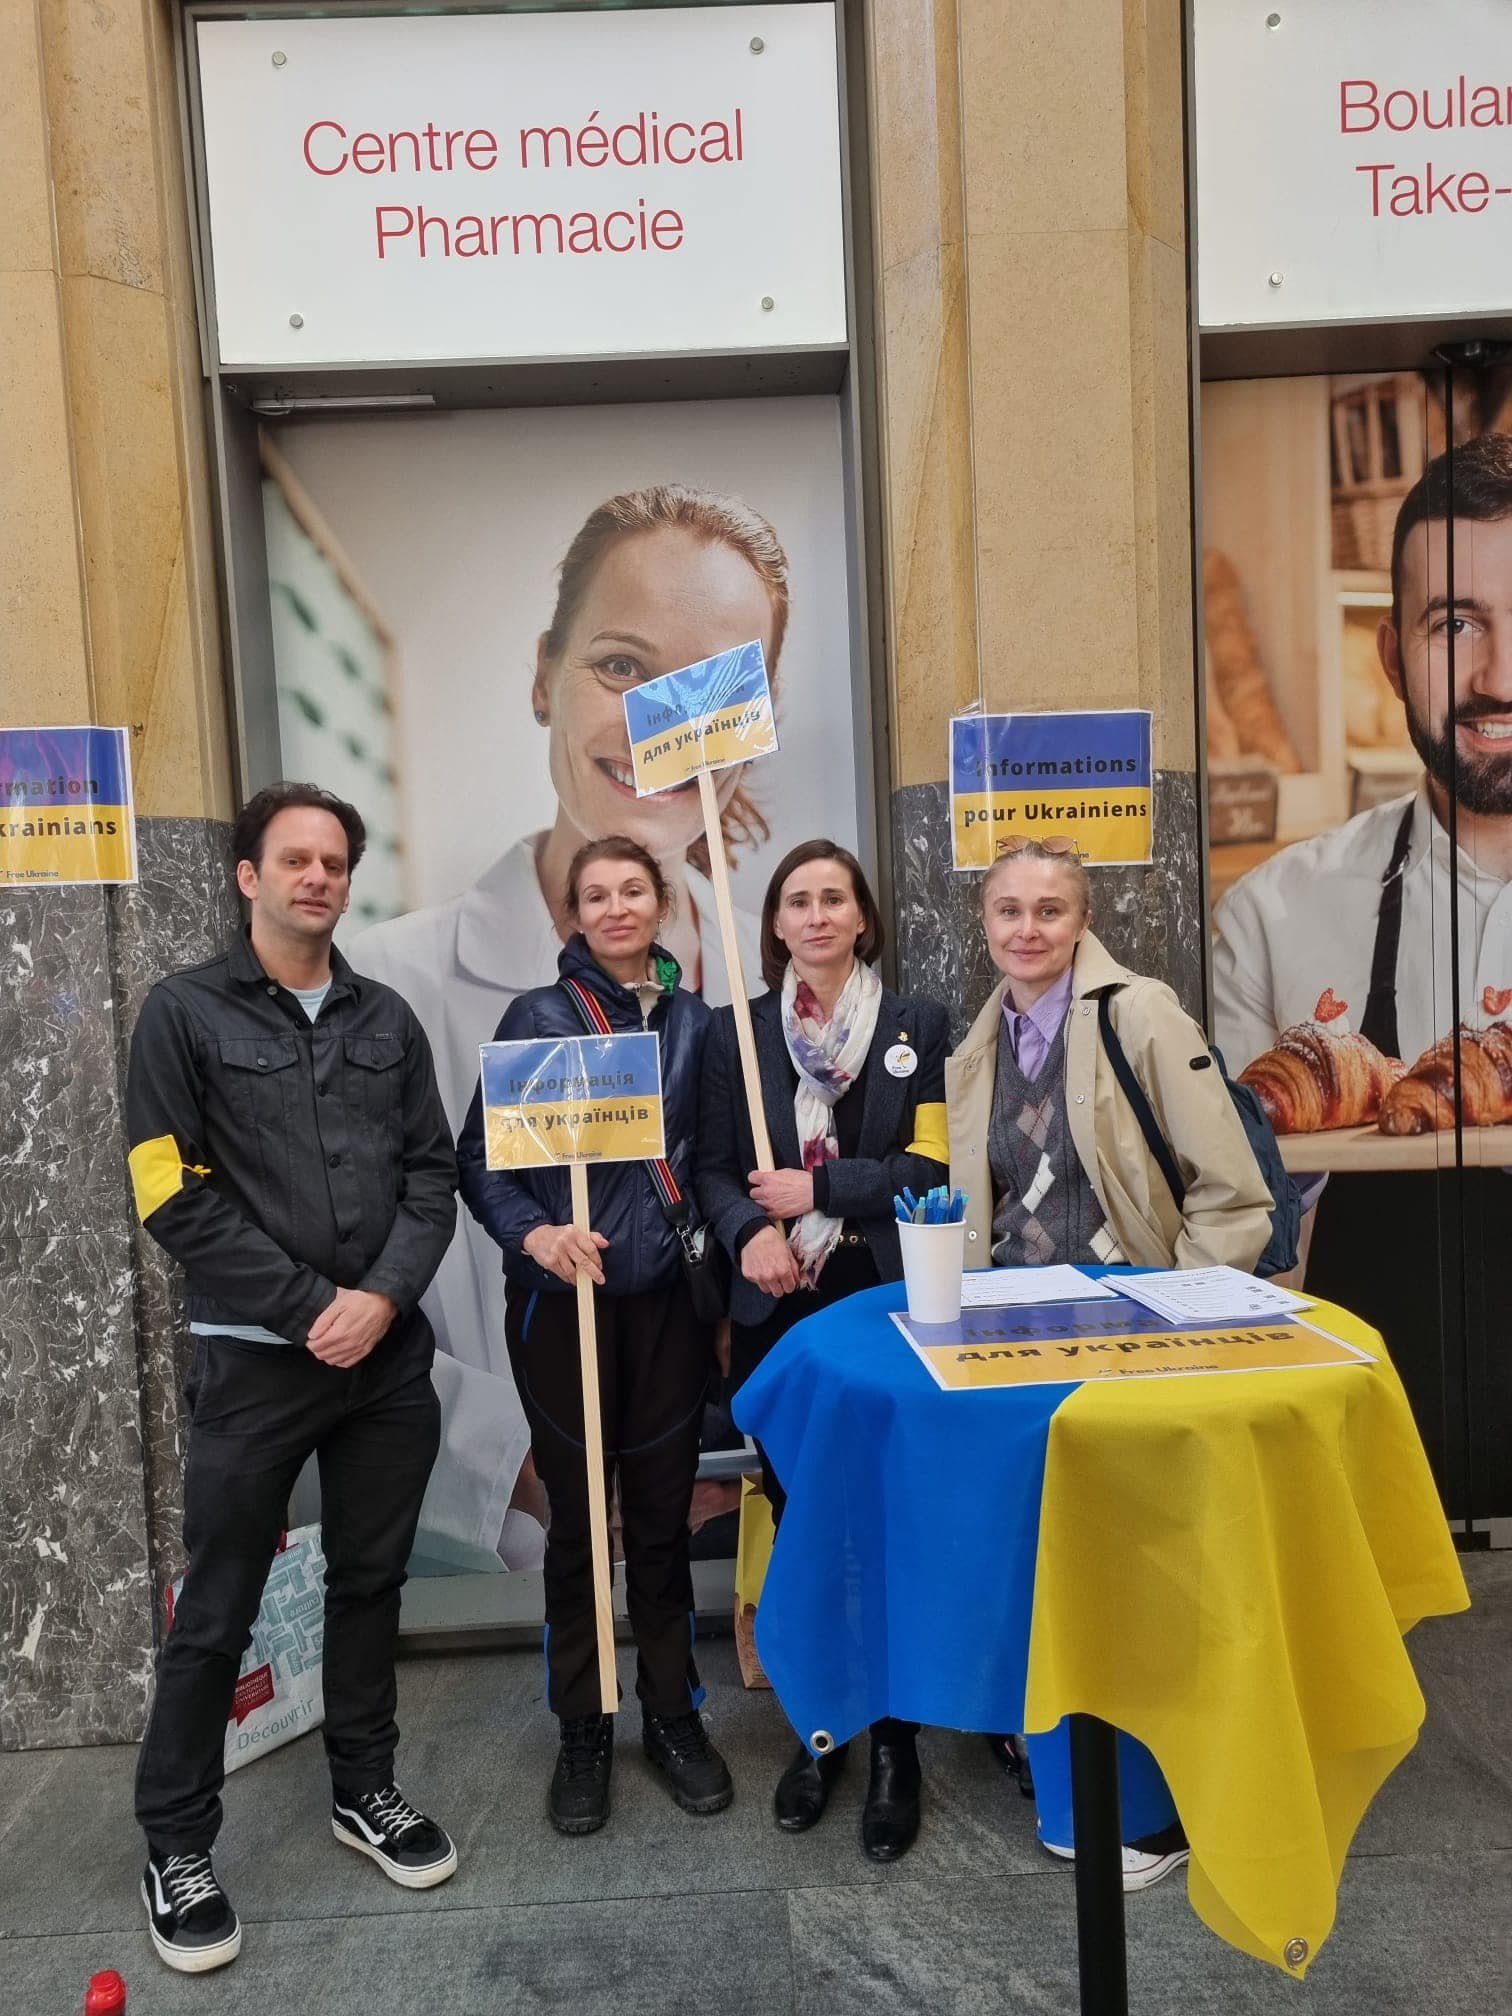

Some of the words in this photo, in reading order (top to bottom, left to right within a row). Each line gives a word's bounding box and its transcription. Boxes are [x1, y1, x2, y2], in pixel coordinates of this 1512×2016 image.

[303, 120, 498, 176] Centre
[520, 108, 744, 169] médical
[375, 198, 684, 259] Pharmacie
[643, 741, 671, 764] для
[964, 807, 1017, 828] pour
[1025, 801, 1147, 820] Ukrainiens
[545, 1105, 649, 1130] українців
[965, 1318, 1159, 1337] Інформа
[956, 1348, 1042, 1362] для
[1056, 1331, 1295, 1357] українців
[238, 1698, 314, 1750] Découvrir
